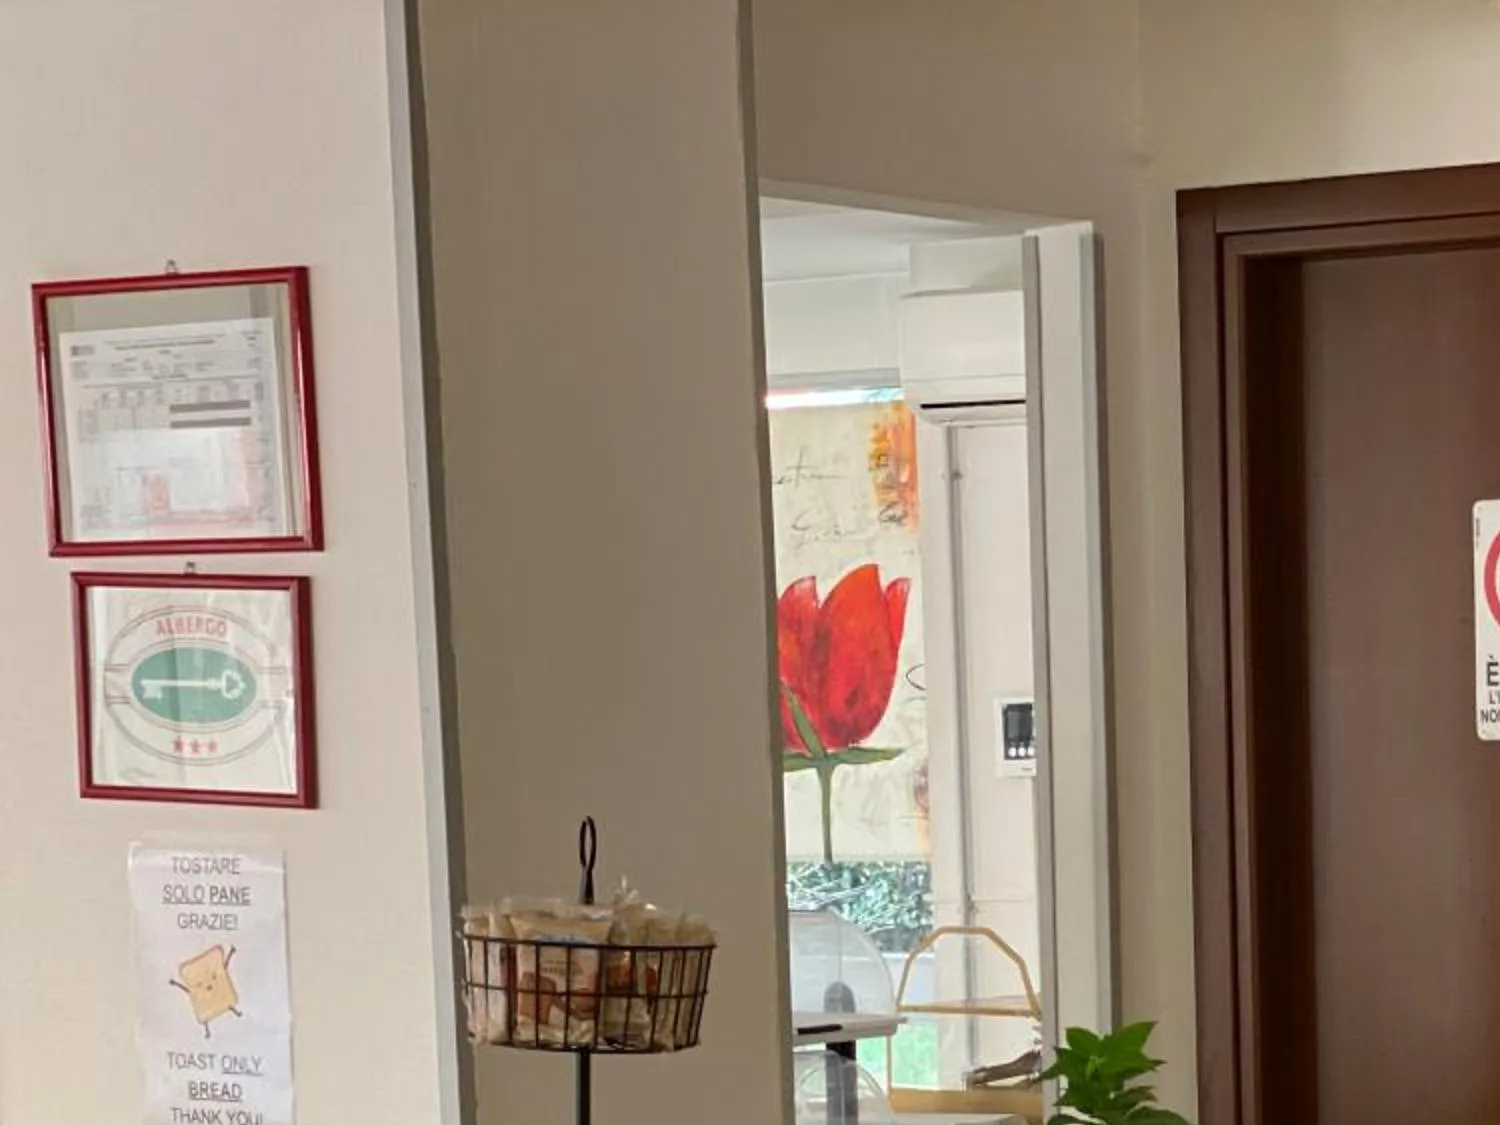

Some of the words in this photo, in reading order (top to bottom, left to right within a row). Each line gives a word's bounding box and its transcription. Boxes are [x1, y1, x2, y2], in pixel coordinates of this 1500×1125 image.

[156, 616, 228, 638] ALBERGO
[1485, 654, 1500, 687] È
[171, 856, 242, 875] TOSTARE
[162, 883, 206, 904] SOLO
[208, 884, 252, 906] PANE
[177, 912, 239, 930] GRAZIE!
[165, 1051, 217, 1071] TOAST
[220, 1054, 265, 1076] ONLY
[188, 1080, 243, 1102] BREAD
